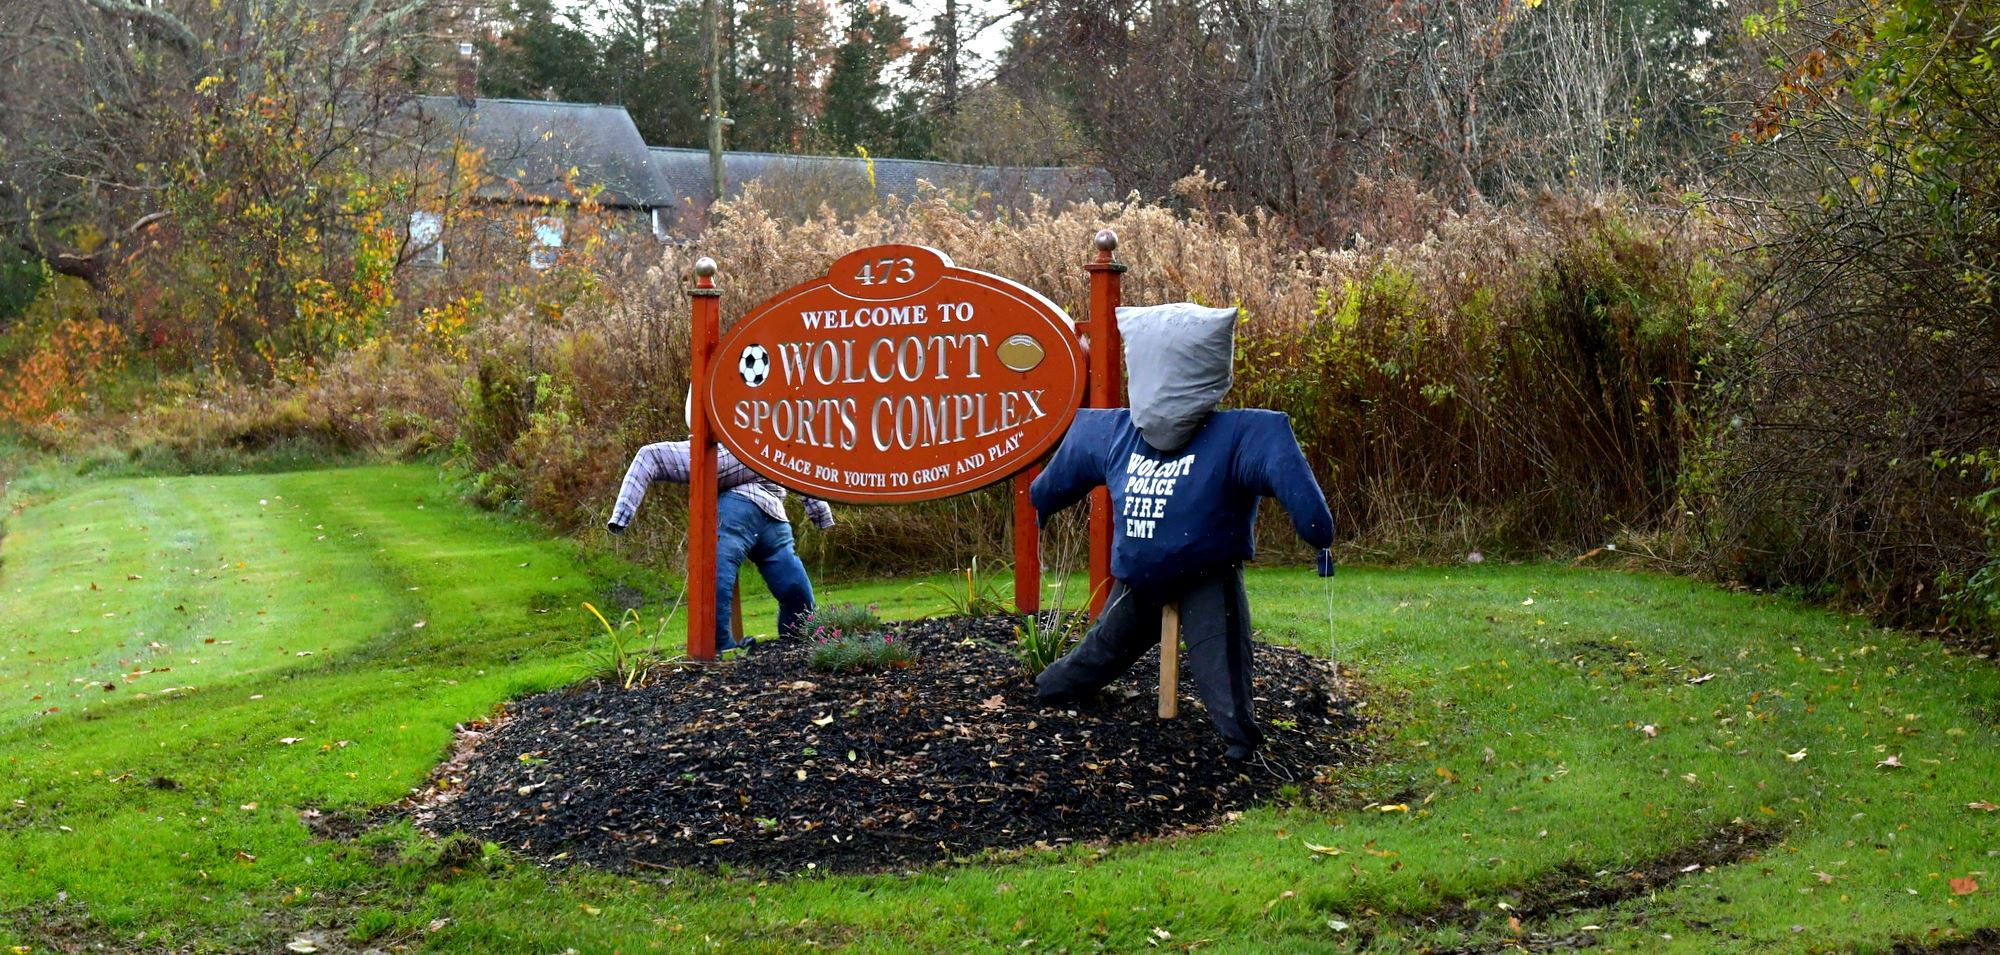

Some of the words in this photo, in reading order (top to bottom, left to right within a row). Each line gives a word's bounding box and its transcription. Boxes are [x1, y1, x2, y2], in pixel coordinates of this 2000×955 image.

[854, 258, 916, 286] 473
[801, 306, 927, 330] WELCOME
[938, 302, 974, 322] TO
[778, 333, 989, 386] WOLCOTT
[734, 395, 857, 451] SPORTS
[871, 390, 1047, 452] COMPLEX
[773, 450, 812, 476] PLACE
[815, 465, 839, 482] FOR
[844, 470, 886, 488] YOUTH
[890, 473, 908, 487] TO
[912, 464, 950, 484] GROW
[956, 454, 985, 474] AND
[1126, 453, 1195, 478] WOLCOTT
[1125, 476, 1177, 495] POLICE
[1123, 497, 1167, 518] FIRE
[1126, 519, 1155, 539] EMT
